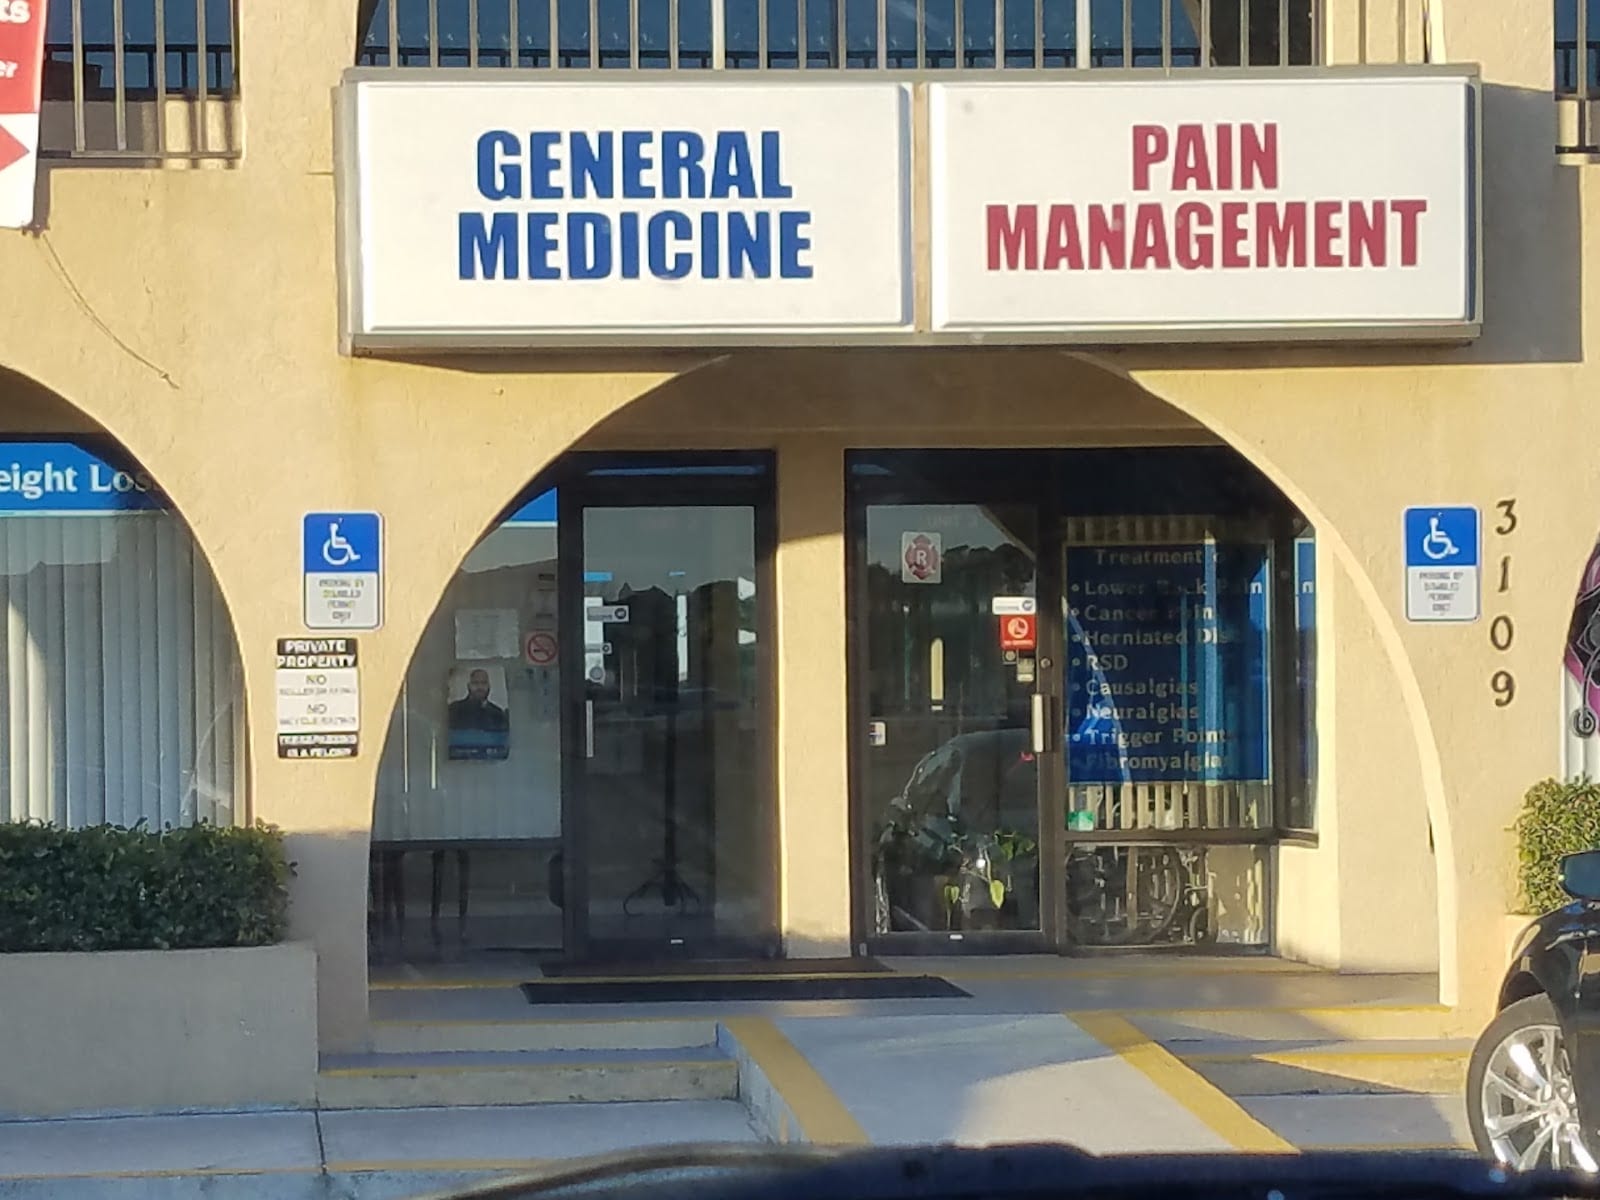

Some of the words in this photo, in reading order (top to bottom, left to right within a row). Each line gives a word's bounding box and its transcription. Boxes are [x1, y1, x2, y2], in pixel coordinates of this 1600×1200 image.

[476, 129, 793, 201] GENERAL
[1132, 122, 1278, 191] PAIN
[458, 209, 814, 280] MEDICINE
[985, 199, 1427, 271] MANAGEMENT
[1084, 604, 1157, 622] Cancer
[284, 639, 347, 654] PRIVATE
[1086, 629, 1188, 646] Herniated
[276, 654, 356, 669] PROPERTY
[1086, 654, 1129, 671] RSD
[306, 674, 328, 686] NO
[1086, 678, 1200, 698] Causalgias
[1086, 702, 1201, 724] Neuralgias
[1086, 728, 1164, 749] Trigger
